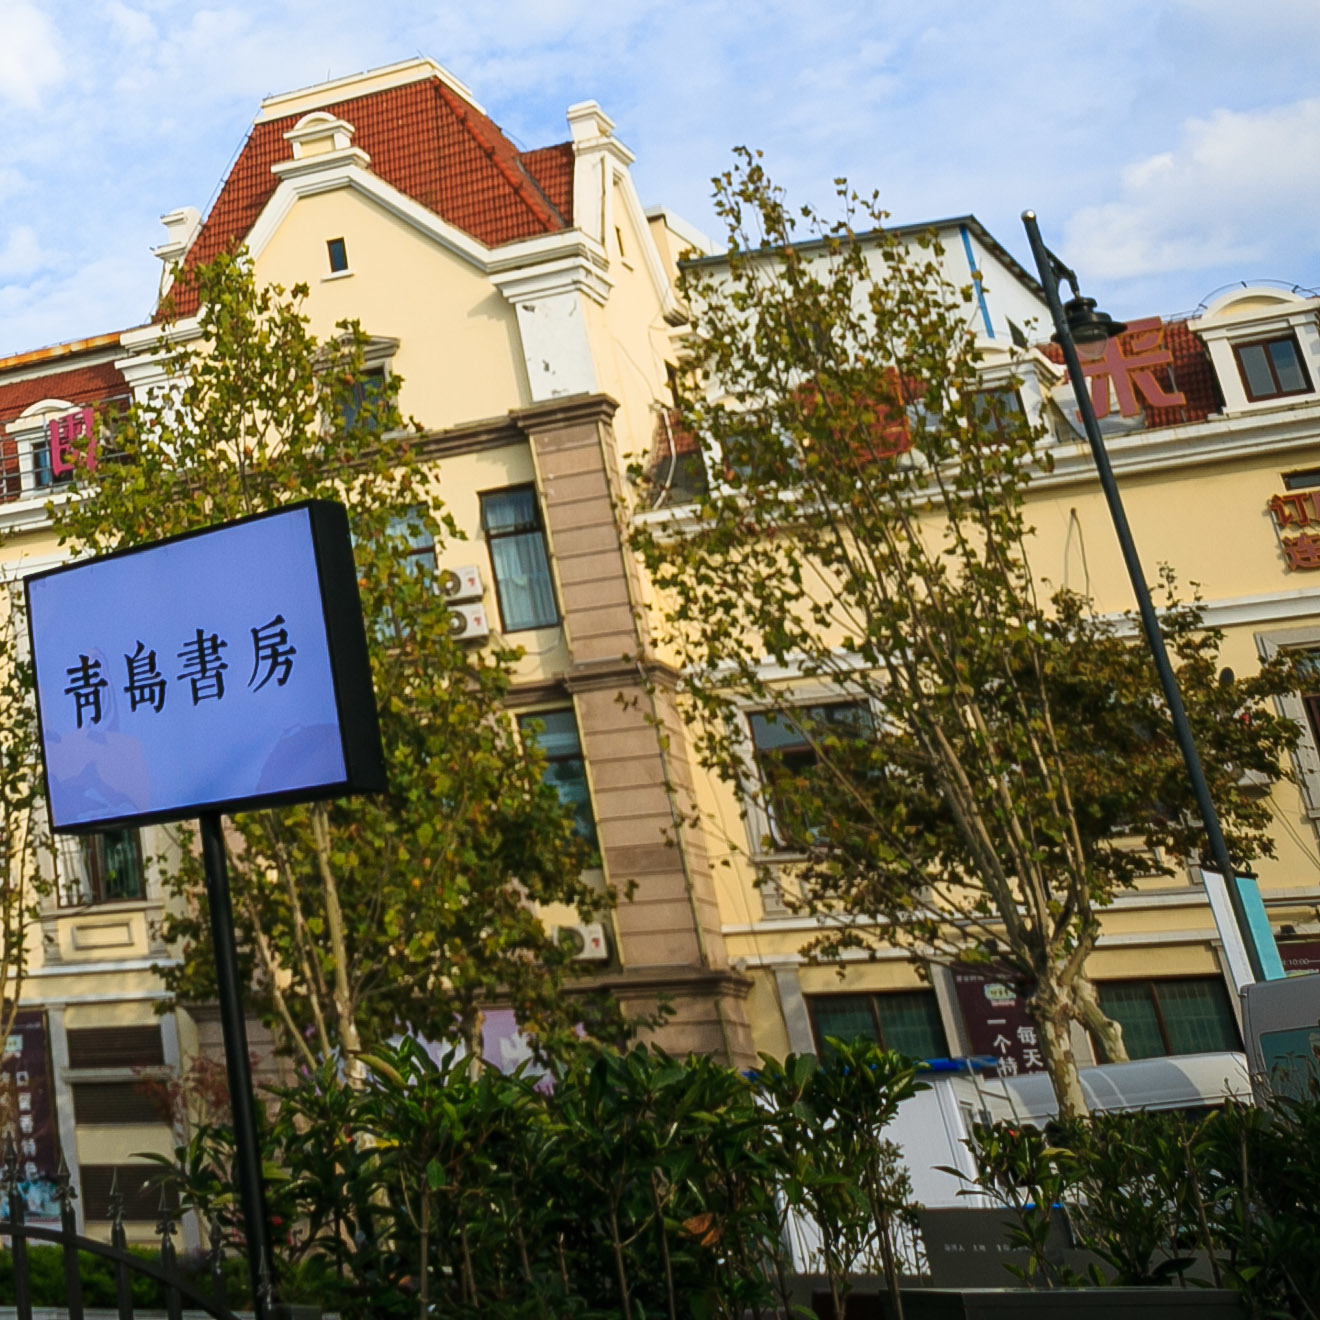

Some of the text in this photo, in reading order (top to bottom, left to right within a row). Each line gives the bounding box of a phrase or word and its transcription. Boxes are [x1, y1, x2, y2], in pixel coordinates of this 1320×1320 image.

[64, 614, 298, 730] 青島書房
[1017, 1026, 1044, 1075] 每天
